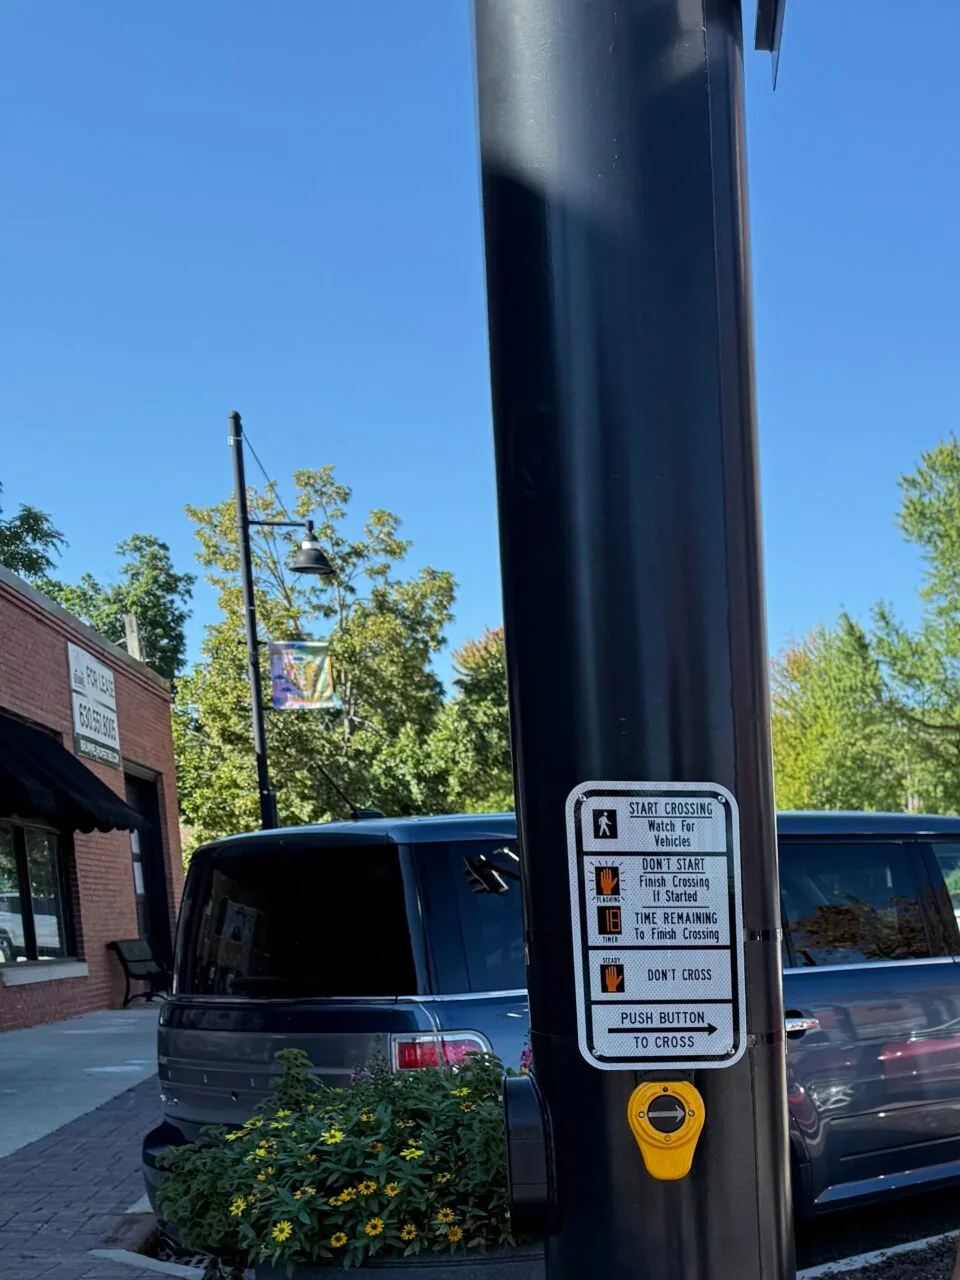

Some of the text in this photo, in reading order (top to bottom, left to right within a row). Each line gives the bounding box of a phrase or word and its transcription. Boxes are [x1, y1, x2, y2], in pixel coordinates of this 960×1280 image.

[85, 664, 99, 690] FOR
[629, 802, 713, 815] START CROSSING
[648, 819, 695, 833] Watch For
[654, 835, 691, 847] Vehicles
[642, 857, 705, 871] DON'T START
[639, 875, 710, 891] Finish Crossing
[653, 889, 698, 902] If Started
[635, 912, 718, 925] TIME REMAINING
[635, 927, 720, 943] To Finish Crossing
[647, 968, 712, 981] DON'T CROSS
[621, 1011, 705, 1025] PUSH BUTTON
[634, 1036, 695, 1049] TO CROSS
